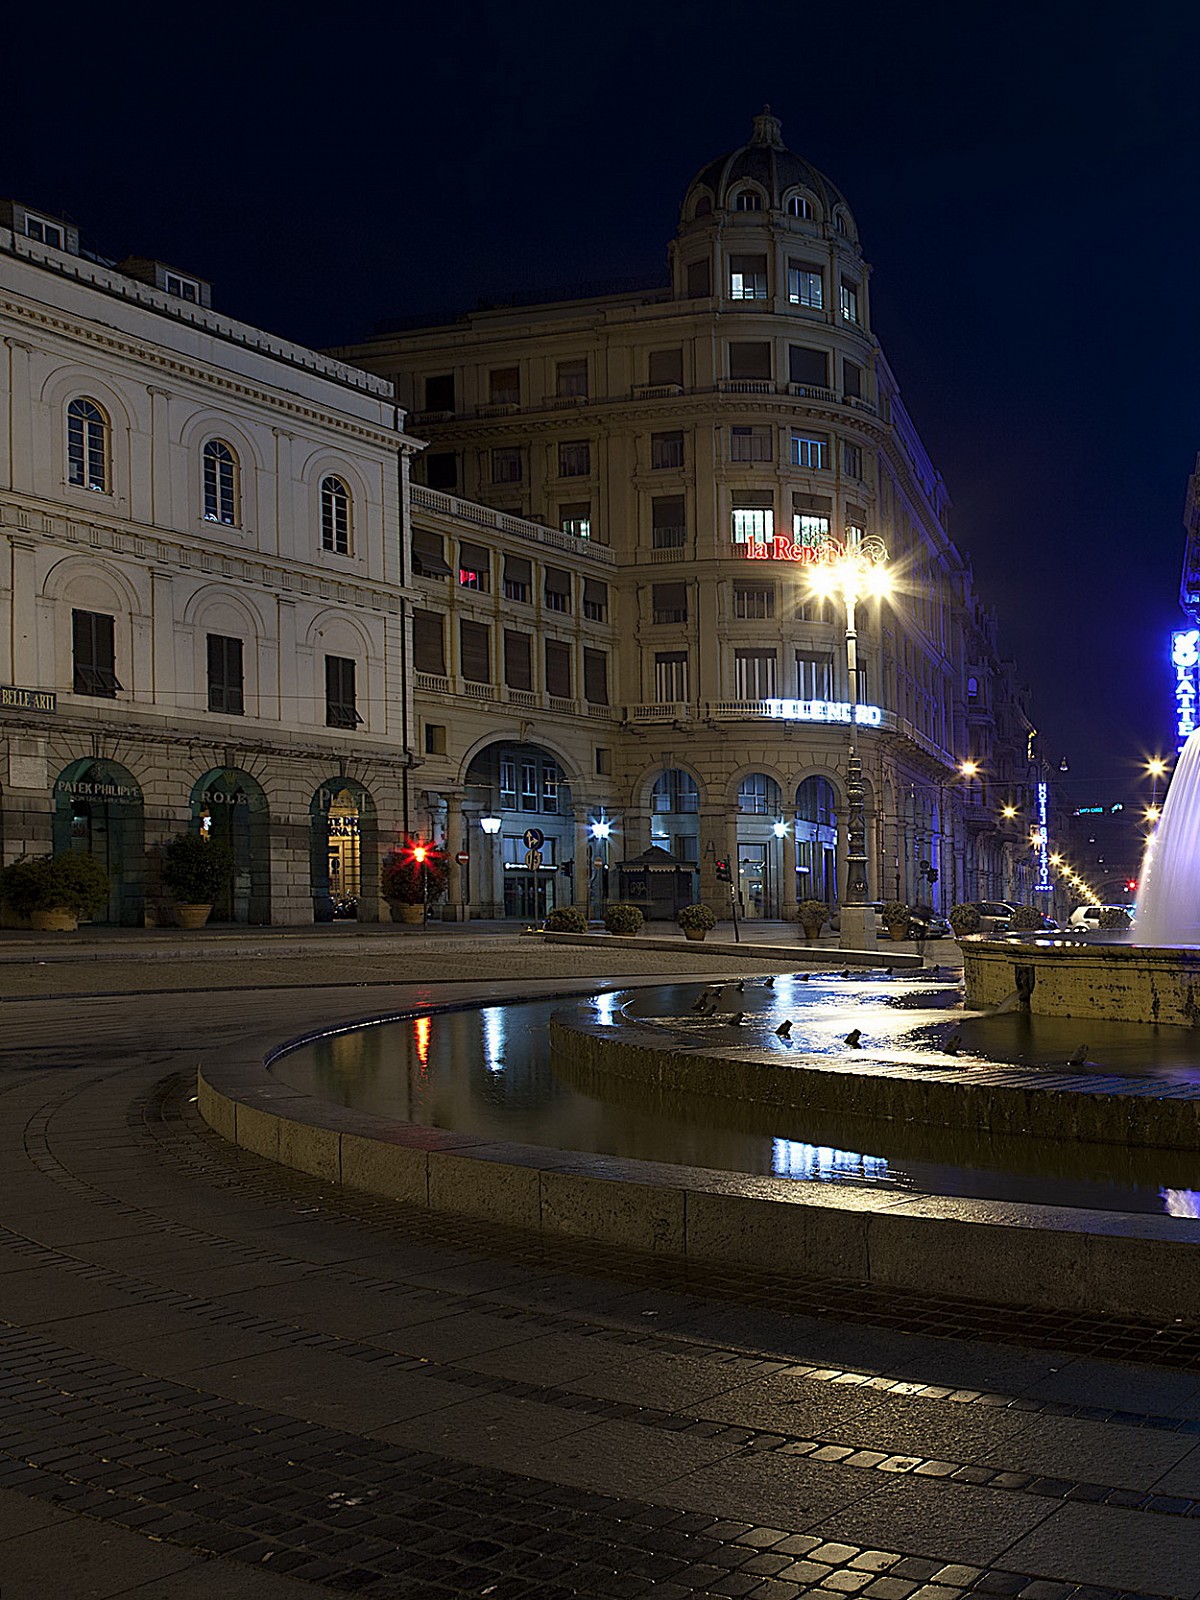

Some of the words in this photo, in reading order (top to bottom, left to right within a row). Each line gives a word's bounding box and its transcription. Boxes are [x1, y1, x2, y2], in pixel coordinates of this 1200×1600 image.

[747, 535, 768, 559] la
[33, 693, 55, 710] ARTI
[1176, 666, 1196, 736] LATTE
[58, 781, 92, 795] PATEK
